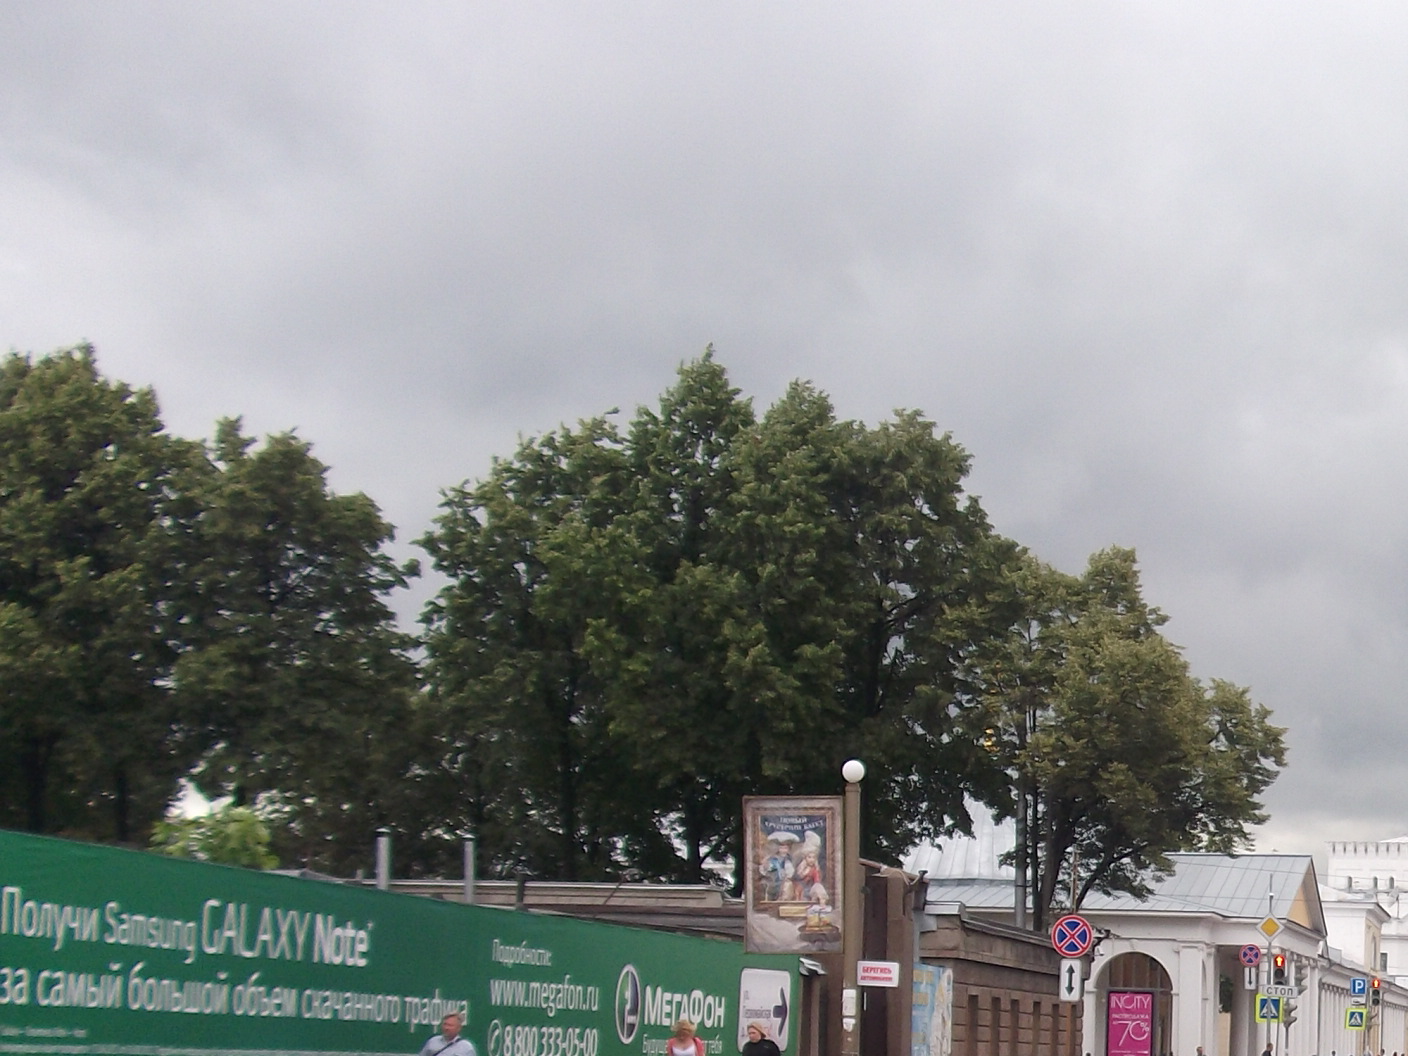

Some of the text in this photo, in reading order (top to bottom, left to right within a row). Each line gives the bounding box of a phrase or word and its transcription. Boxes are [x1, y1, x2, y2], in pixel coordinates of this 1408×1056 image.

[1, 886, 100, 951] Получи
[104, 901, 196, 964] Samsung
[202, 899, 311, 961] GALAXY
[0, 967, 30, 1004] за
[37, 962, 123, 1008] самый
[128, 961, 230, 1014] большой
[233, 972, 297, 1017] объем
[302, 988, 400, 1024] скачанного
[490, 974, 599, 1017] www.megafon.ru
[1111, 995, 1150, 1009] INCITY
[1266, 986, 1293, 996] СТОП
